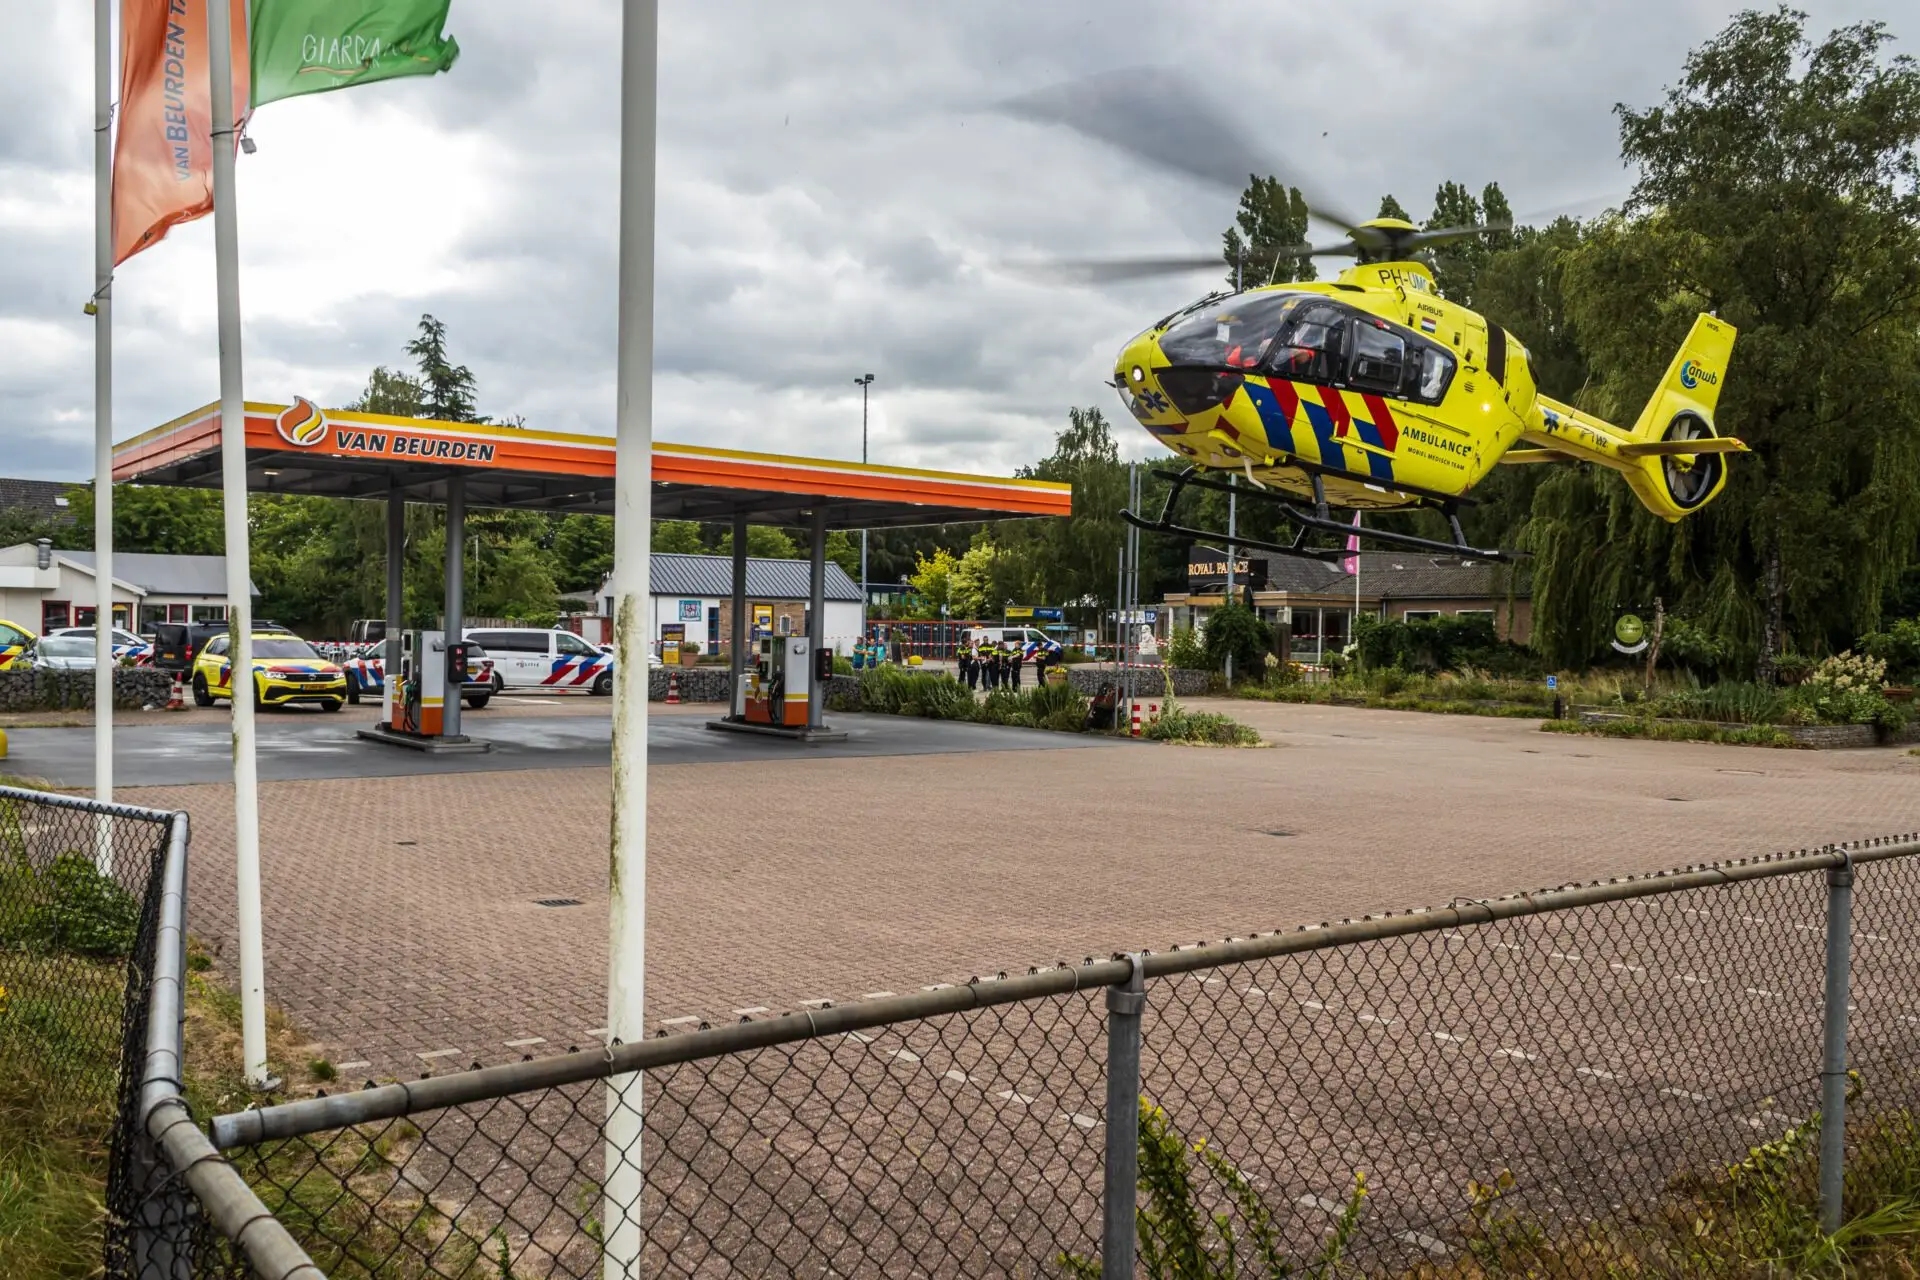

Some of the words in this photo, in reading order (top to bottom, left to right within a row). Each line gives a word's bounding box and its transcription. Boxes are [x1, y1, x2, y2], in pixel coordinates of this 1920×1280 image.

[164, 22, 188, 143] BEURDEN
[174, 146, 192, 182] VAN
[1417, 302, 1444, 317] AIRBUS
[1688, 366, 1717, 385] anwb
[336, 430, 387, 453] VAN
[392, 436, 496, 462] BEURDEN
[1402, 425, 1469, 457] AMBULANCE
[1451, 461, 1465, 471] TEAM
[1188, 562, 1215, 576] ROYAL
